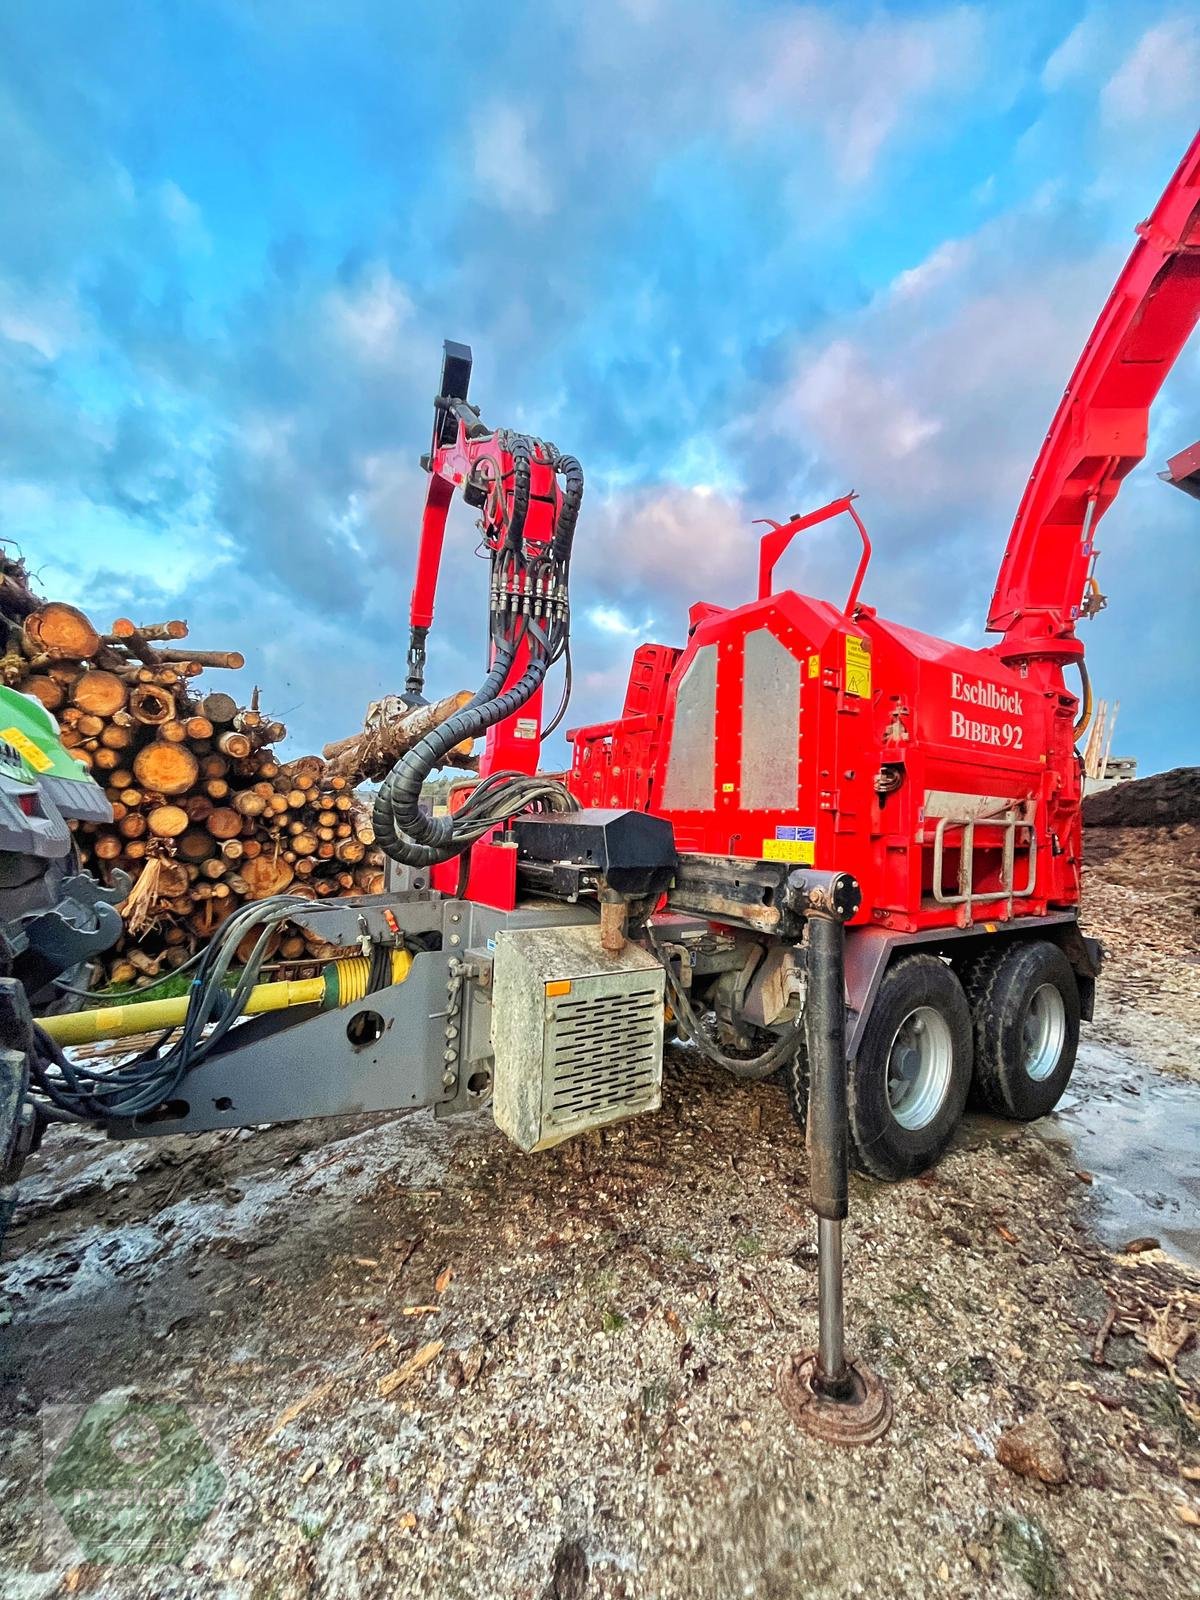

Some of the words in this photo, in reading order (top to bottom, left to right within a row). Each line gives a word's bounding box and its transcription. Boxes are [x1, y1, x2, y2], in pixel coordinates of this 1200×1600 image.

[951, 672, 1023, 716] Eschlböck
[951, 710, 1001, 746] BIBER
[1002, 723, 1023, 750] 92
